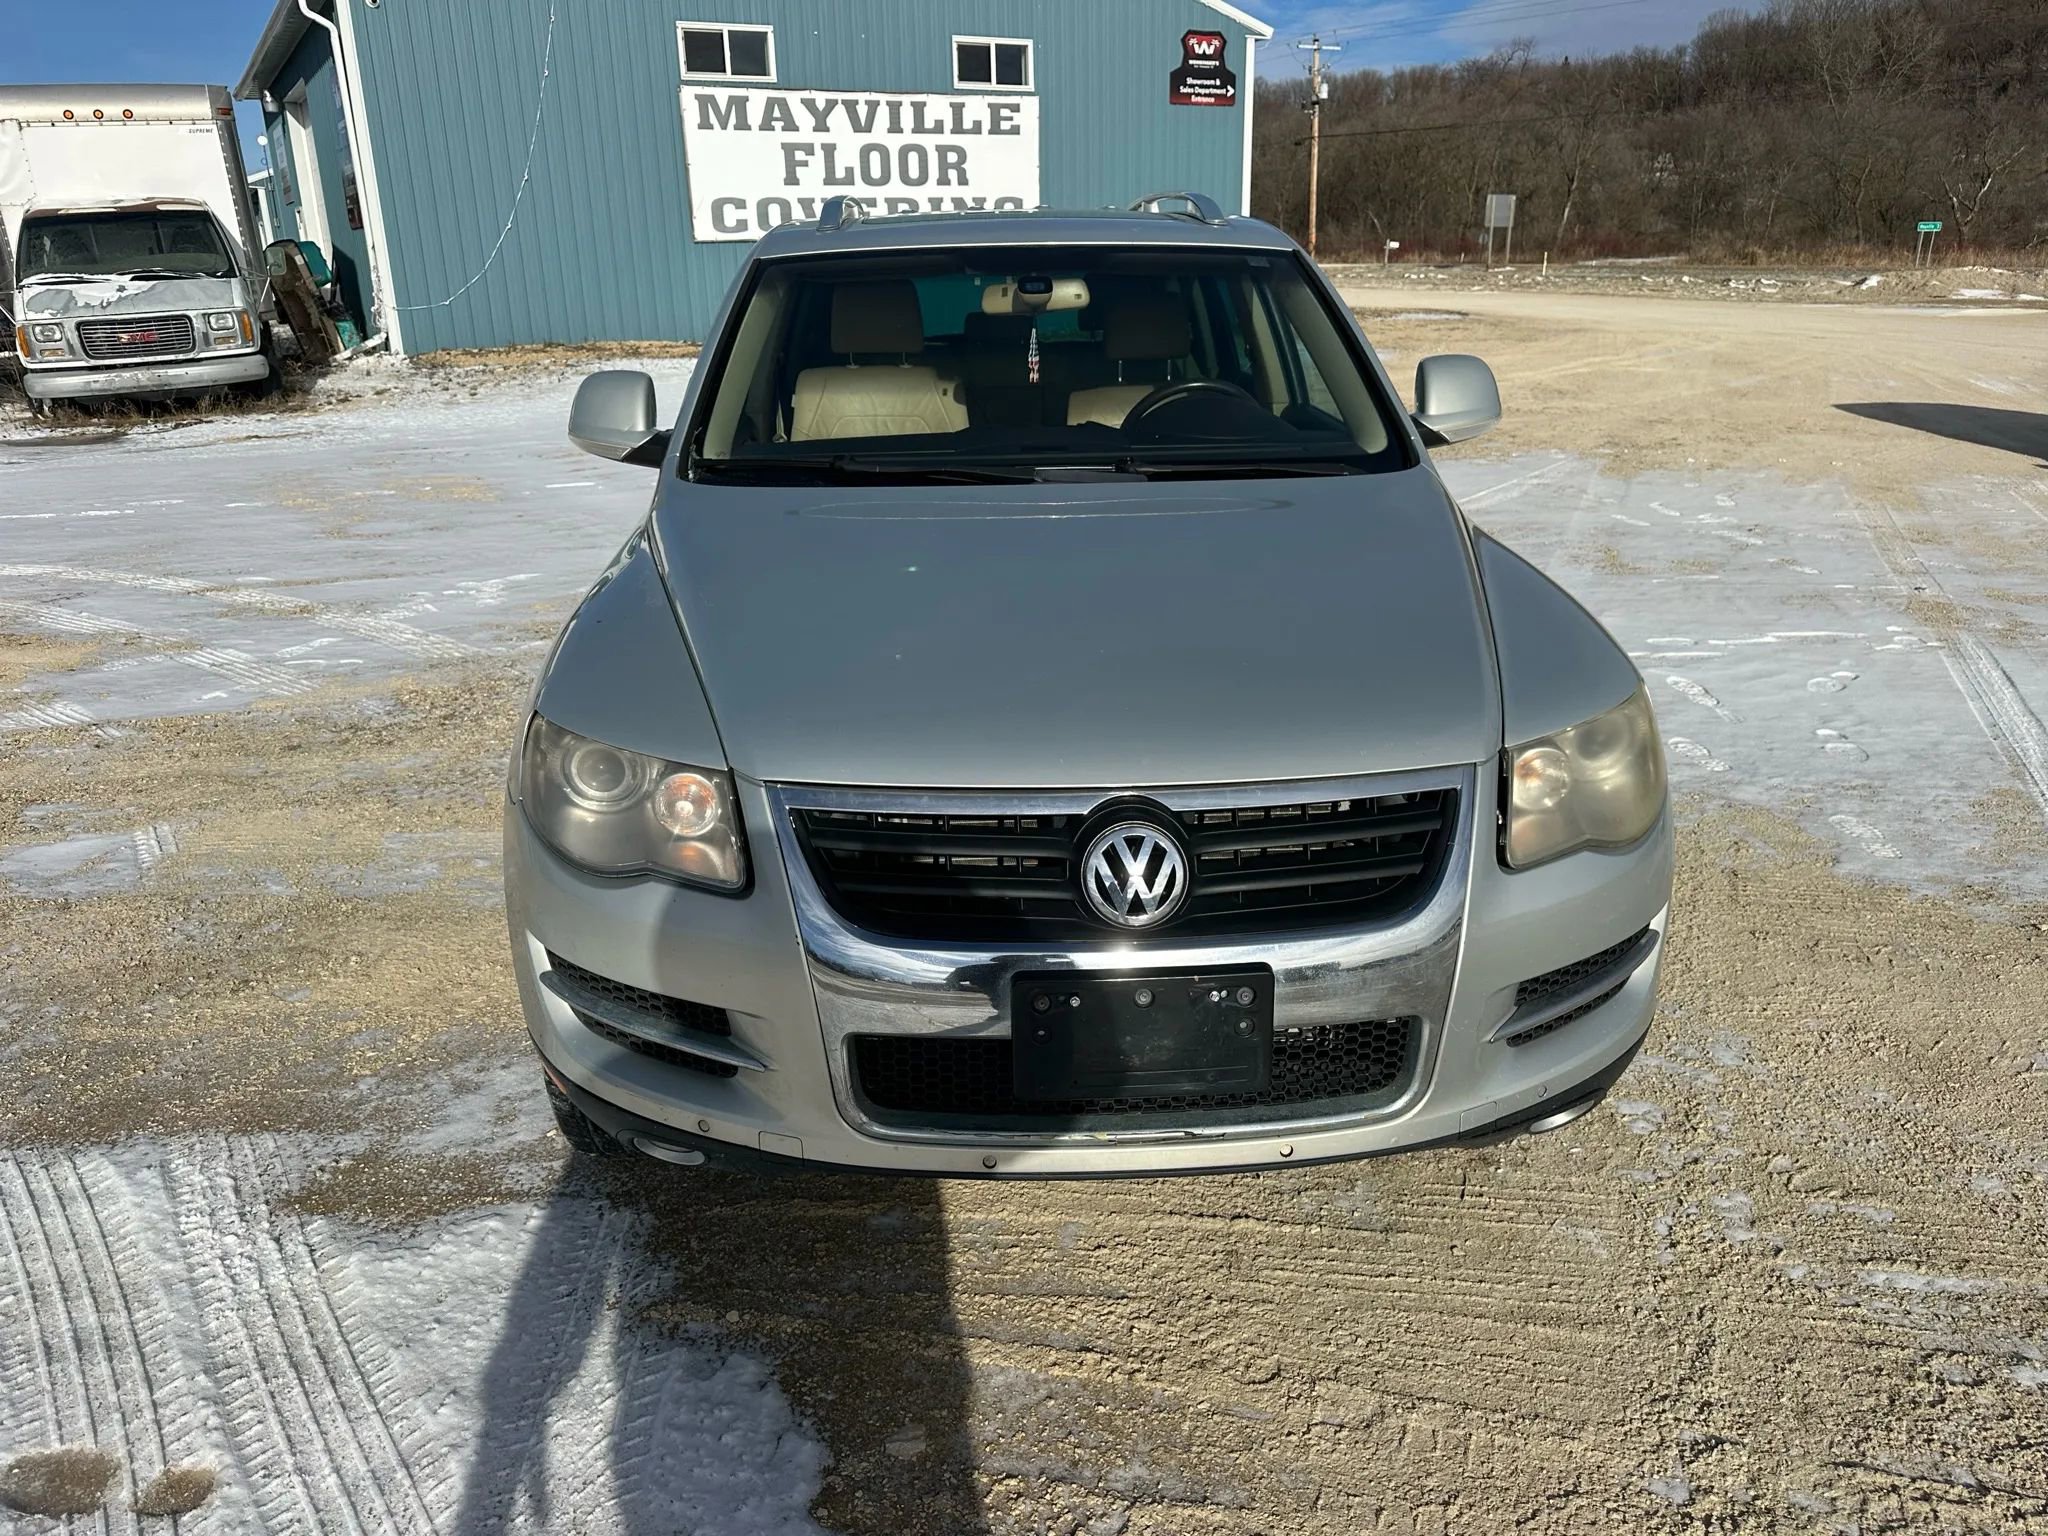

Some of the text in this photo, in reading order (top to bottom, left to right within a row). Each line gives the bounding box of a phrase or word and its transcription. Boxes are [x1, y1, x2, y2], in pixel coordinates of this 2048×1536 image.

[1186, 77, 1215, 85] Showroom
[1180, 85, 1227, 95] Sales Department
[1191, 95, 1215, 103] Entrance
[695, 94, 1020, 135] MAYVILLE
[781, 142, 969, 186] FLOOR
